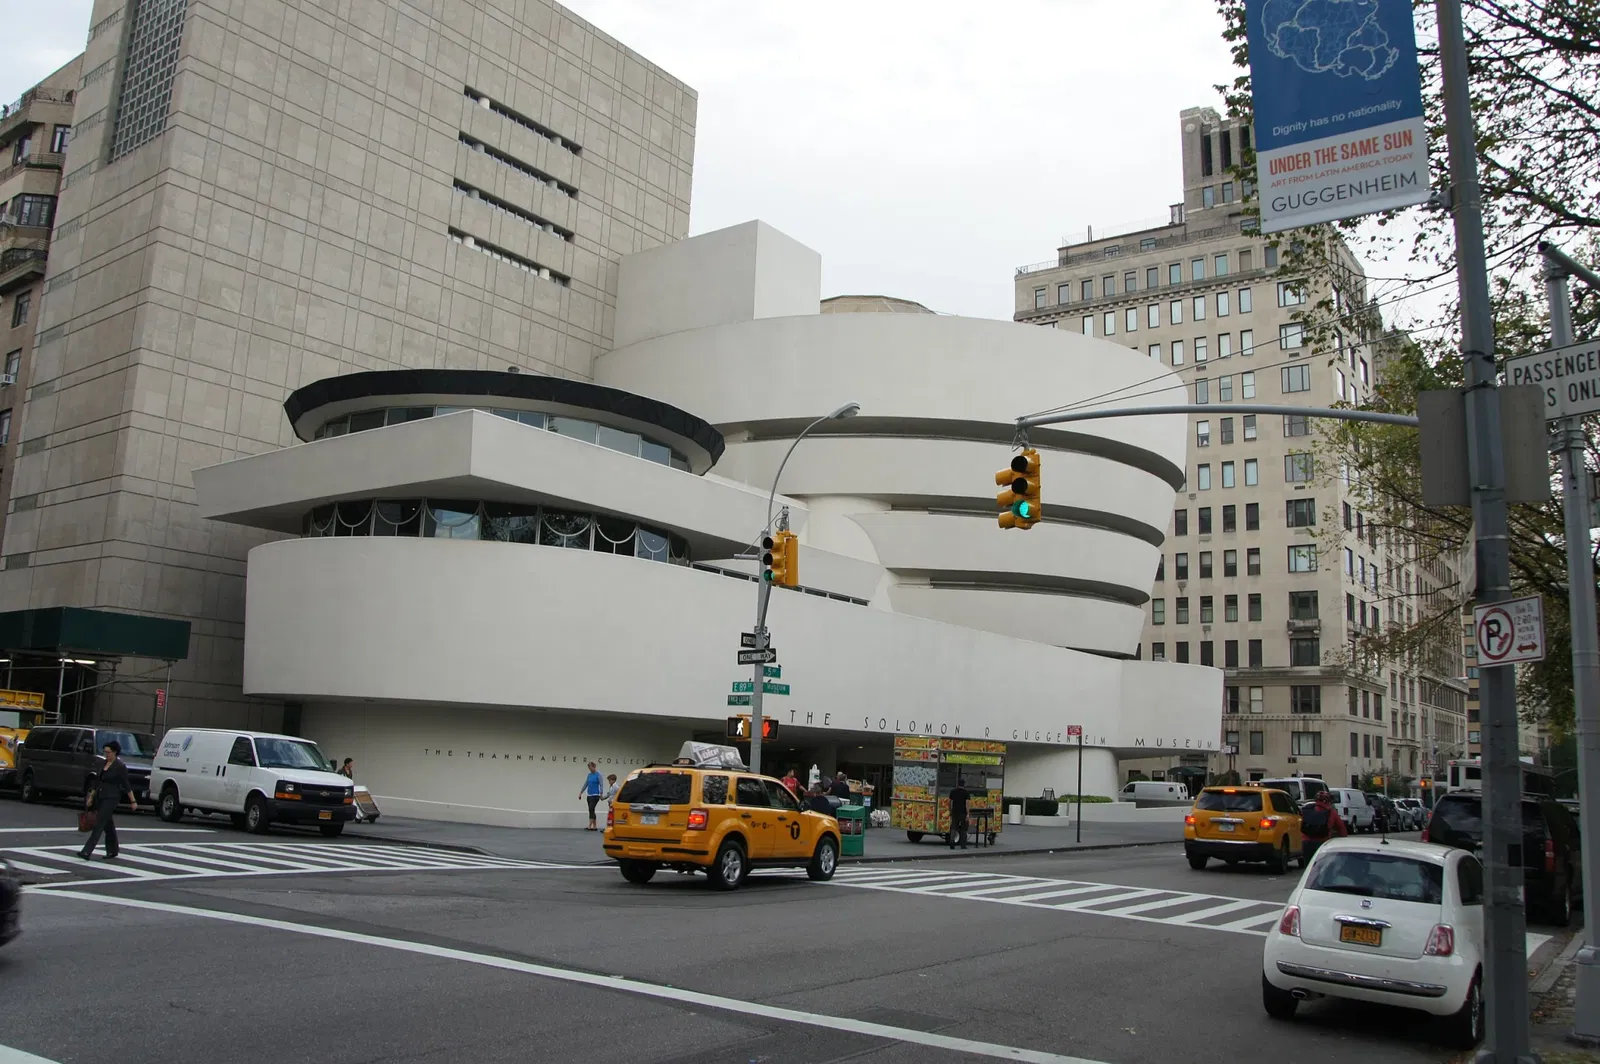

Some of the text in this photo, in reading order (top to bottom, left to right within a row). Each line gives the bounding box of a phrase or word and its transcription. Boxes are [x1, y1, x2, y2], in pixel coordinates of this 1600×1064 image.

[1272, 99, 1402, 136] Dignity has no nationality
[1270, 129, 1413, 175] UNDER THE SAME SUN
[1270, 152, 1414, 188] ART FROM LATIN AMERICA TODAY
[1271, 171, 1418, 212] GUGGENHEIM
[1514, 350, 1600, 386] PASSENGE
[1568, 378, 1600, 402] ONL
[740, 683, 747, 691] 89
[790, 710, 831, 726] THE
[864, 716, 960, 736] SOLOMON
[984, 726, 990, 738] R
[1013, 729, 1106, 746] GUGGENHEIM
[1135, 737, 1212, 749] MUSEUM
[424, 748, 453, 757] THE
[467, 751, 588, 764] THANNHAUSER
